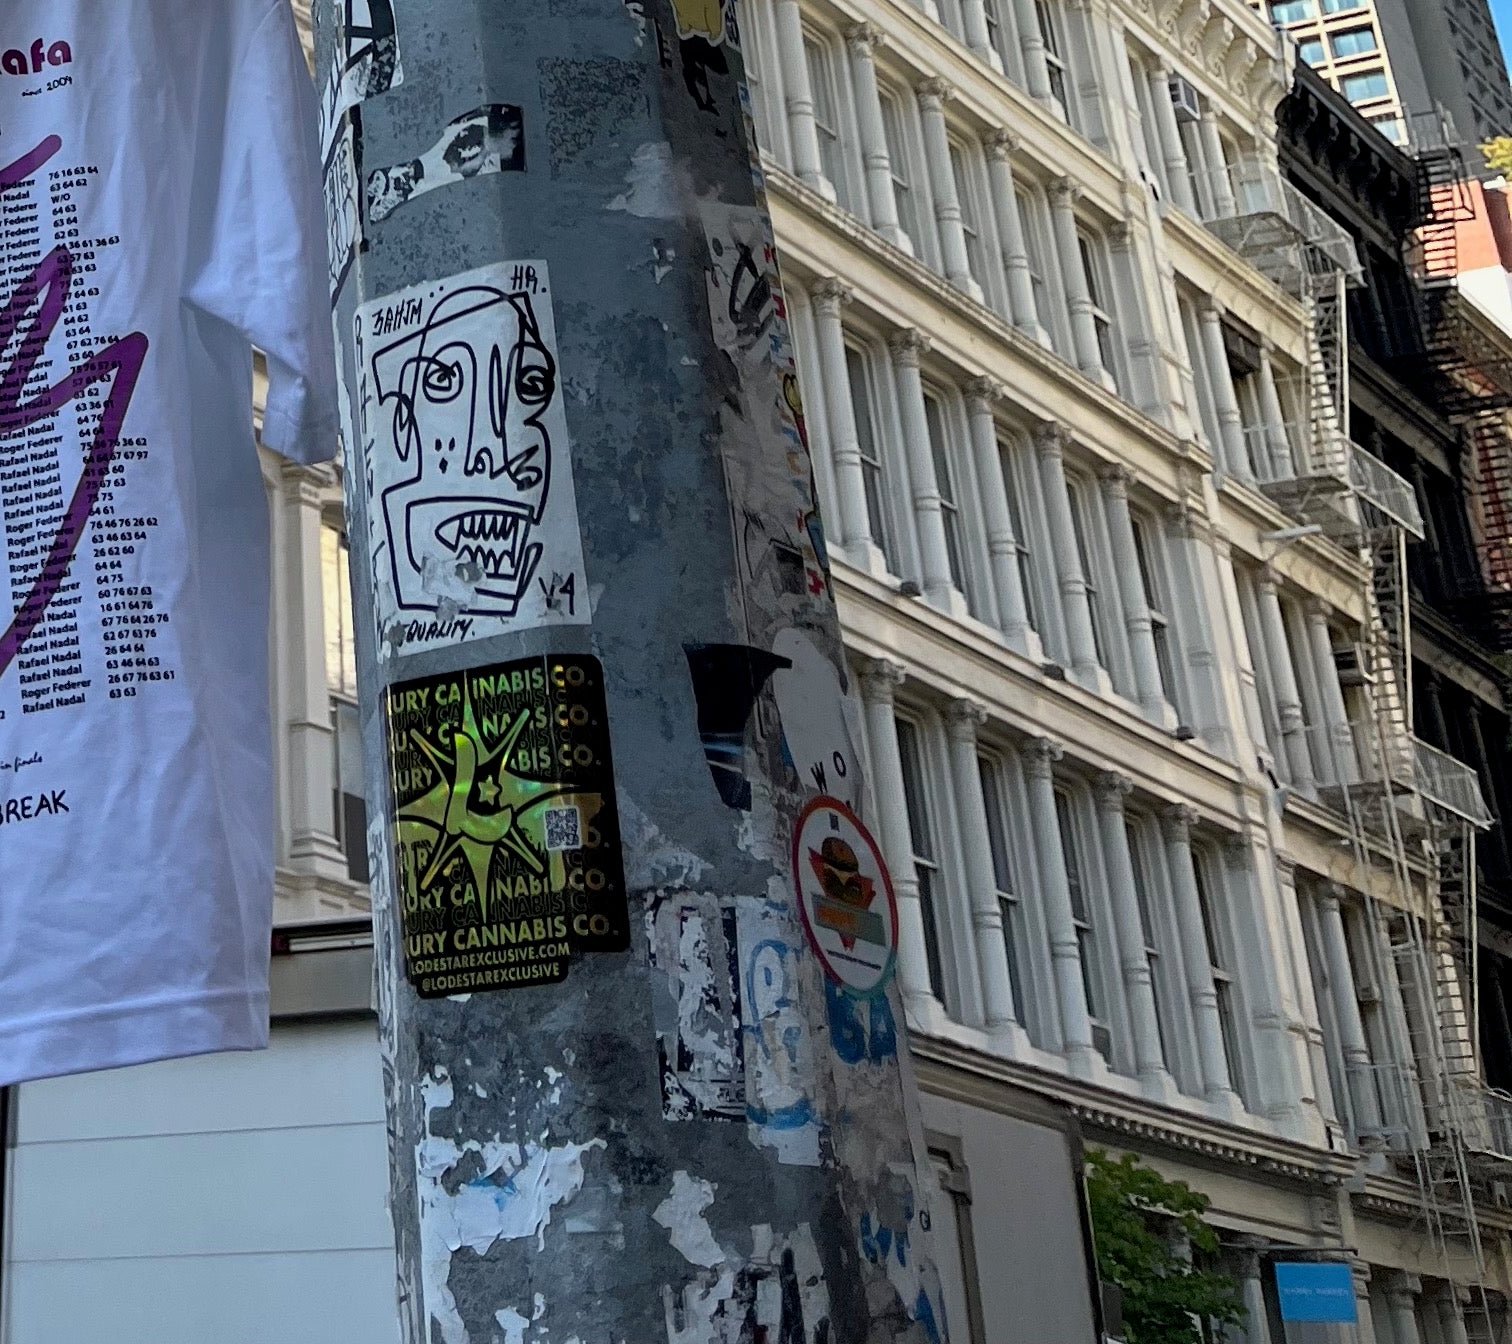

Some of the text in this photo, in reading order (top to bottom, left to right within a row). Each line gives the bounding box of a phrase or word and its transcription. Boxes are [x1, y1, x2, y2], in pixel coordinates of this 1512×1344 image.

[3, 202, 37, 214] Federer
[52, 193, 70, 204] W/O
[4, 214, 38, 226] Federer
[5, 226, 39, 238] Federer
[0, 469, 30, 481] Rafael
[32, 461, 59, 474] Nadal
[2, 481, 32, 494] Rafael
[34, 474, 60, 486] Nadal
[3, 494, 33, 507] Rafael
[35, 487, 62, 499] Nadal
[4, 507, 34, 520] Rafael
[36, 500, 63, 513] Nadal
[17, 643, 48, 655] Rafael
[50, 636, 79, 649] Nadal
[18, 656, 49, 670] Rafael
[51, 650, 81, 663] Nadal
[20, 670, 50, 684] Rafael
[53, 665, 82, 677] Nadal
[21, 686, 50, 699] Roger
[53, 680, 91, 693] Federer
[23, 701, 53, 714] Rafael
[56, 693, 85, 707] Nadal
[453, 915, 567, 951] CANNABIS
[573, 914, 619, 936] CO.
[422, 962, 559, 991] @LODESTAREXCLUSIVE
